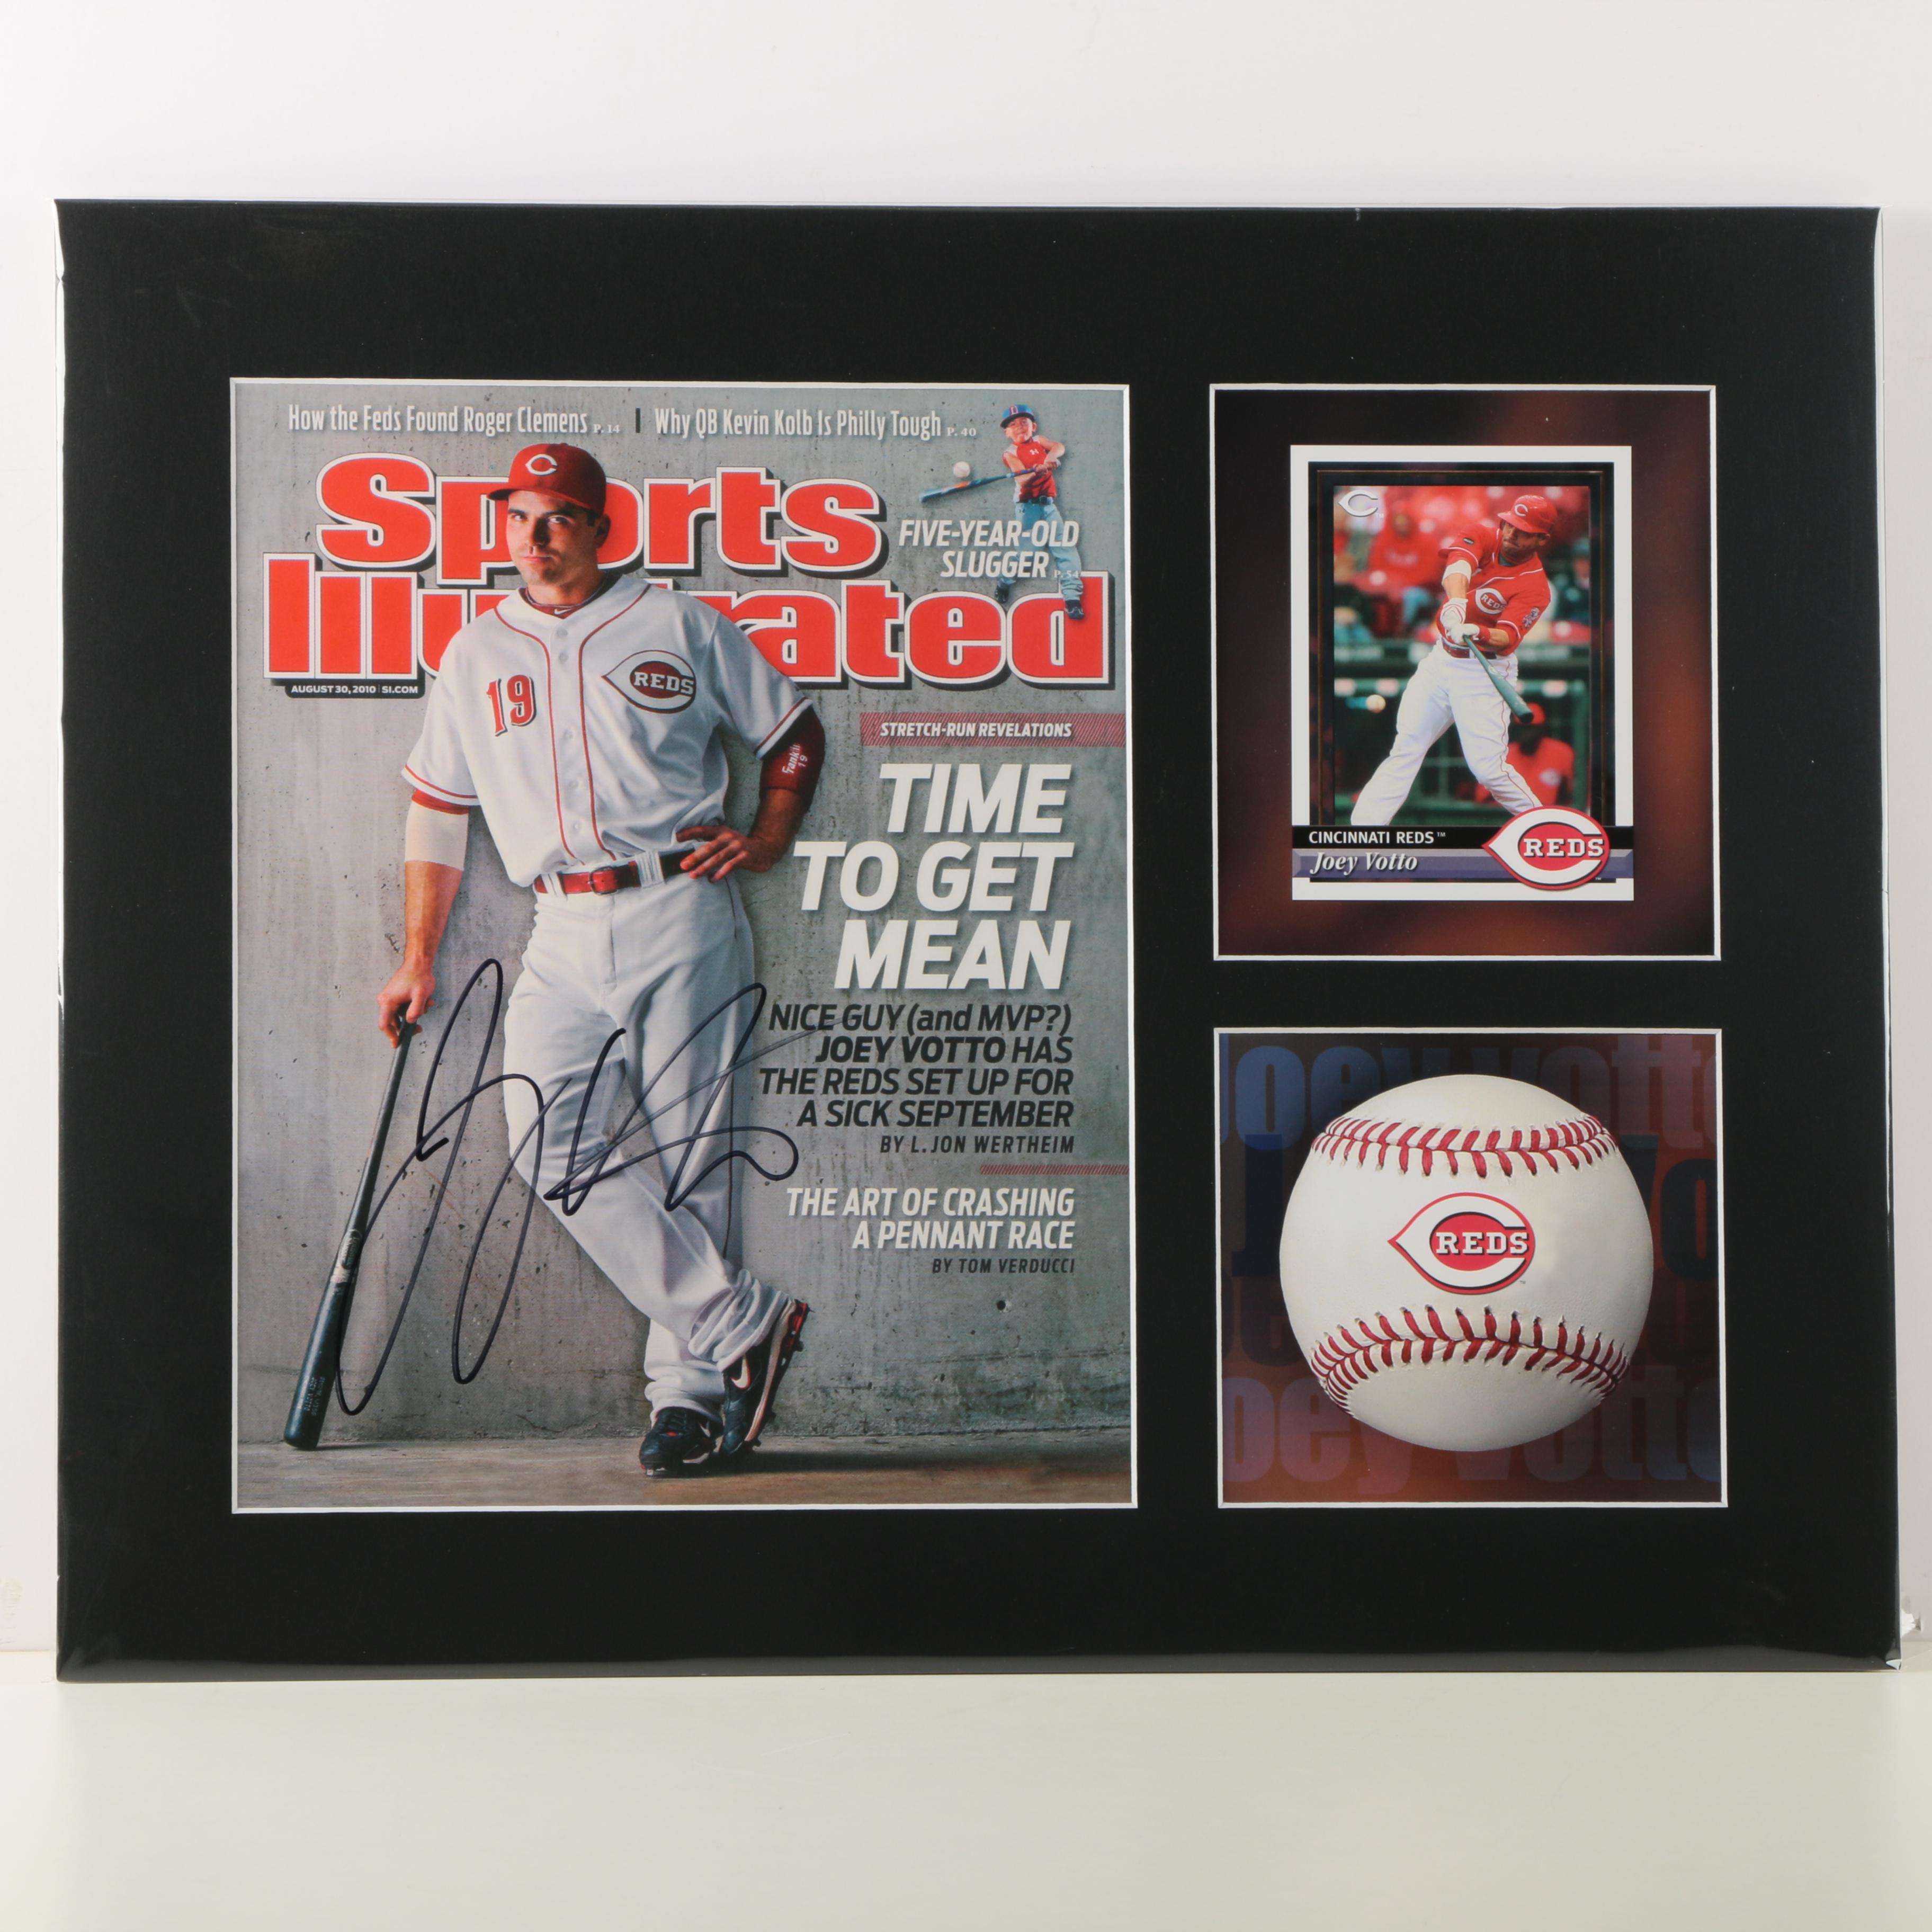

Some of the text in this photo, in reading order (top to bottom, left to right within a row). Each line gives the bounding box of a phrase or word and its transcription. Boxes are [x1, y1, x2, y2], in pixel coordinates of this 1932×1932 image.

[289, 404, 620, 437] How the Feds Found Roger Clemens P. 14
[655, 408, 977, 441] Why QB Kevin Kolb Is Philly Tough P. 40
[898, 520, 1079, 547] FIVE-YEAR-OLD
[940, 550, 1050, 578] SLUGGER
[335, 685, 351, 694] 30,
[633, 671, 695, 695] REDS
[486, 674, 536, 736] 19
[880, 722, 1072, 737] STRETCH-RUN REVELATIONS
[798, 755, 808, 767] 19
[880, 764, 1071, 833] TIME
[1309, 831, 1390, 844] CINCINNATI
[1397, 831, 1434, 844] REDS
[1523, 838, 1604, 858] REDS
[793, 840, 1075, 911] TO GET
[1310, 852, 1418, 875] Joey Votto
[834, 920, 1071, 989] MEAN
[768, 1003, 1071, 1037] NICE GUY (and MVP?)
[815, 1036, 1074, 1063] JOEY VOTTO HAS
[759, 1068, 1074, 1095] THE REDS SET UP FOR
[796, 1099, 1074, 1128] A SICK SEPTEMBER
[880, 1135, 904, 1153] BY
[974, 1135, 1074, 1153] WERTHEIM
[787, 1187, 1075, 1217] THE ART OF CRASHING
[852, 1221, 1075, 1249] A PENNANT RACE
[1435, 1231, 1528, 1255] REDS
[932, 1258, 1075, 1273] BY TOM VERDUCCI
